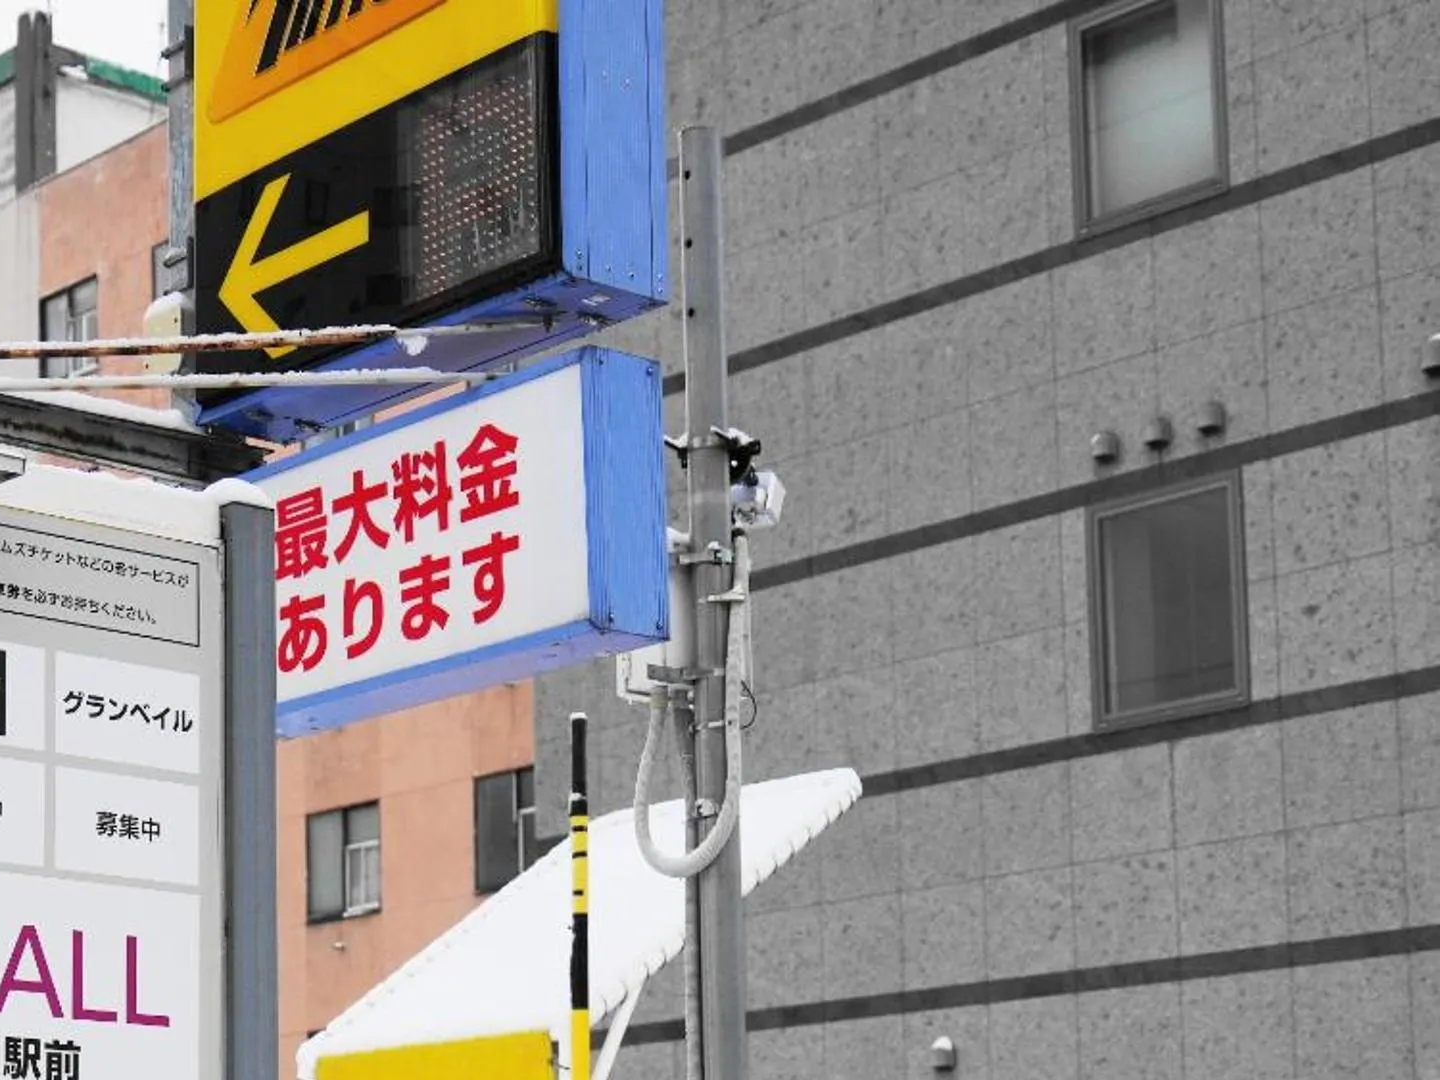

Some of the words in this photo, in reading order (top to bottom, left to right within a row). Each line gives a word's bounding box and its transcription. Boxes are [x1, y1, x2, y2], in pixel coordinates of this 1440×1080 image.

[275, 424, 520, 580] 最大料金
[276, 531, 520, 673] あります
[62, 690, 193, 733] グランベイル
[95, 811, 161, 842] 募集中
